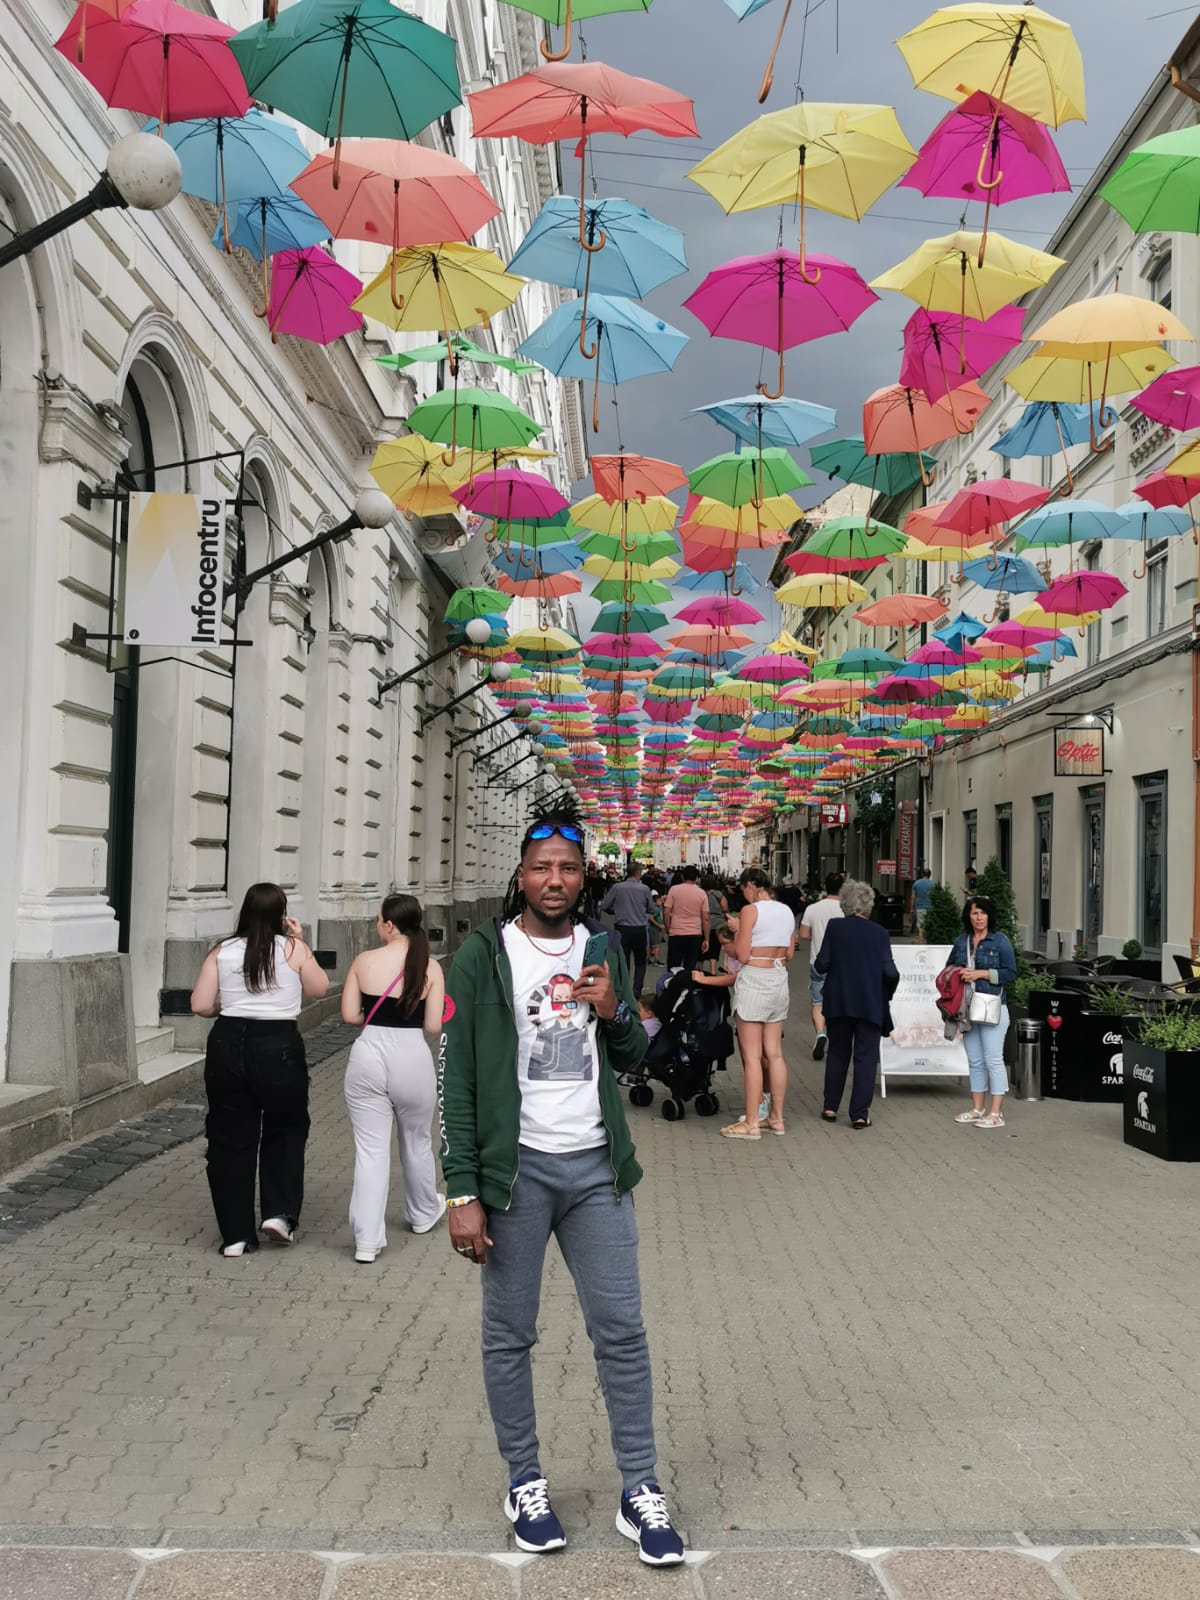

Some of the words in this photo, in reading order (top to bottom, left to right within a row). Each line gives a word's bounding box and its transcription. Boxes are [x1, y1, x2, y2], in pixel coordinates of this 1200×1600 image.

[191, 499, 221, 643] Infocentru
[1057, 740, 1100, 763] Optic
[901, 814, 913, 855] EXCHANGE
[1101, 1076, 1124, 1084] SPAR
[1133, 1117, 1157, 1134] SPARTAN
